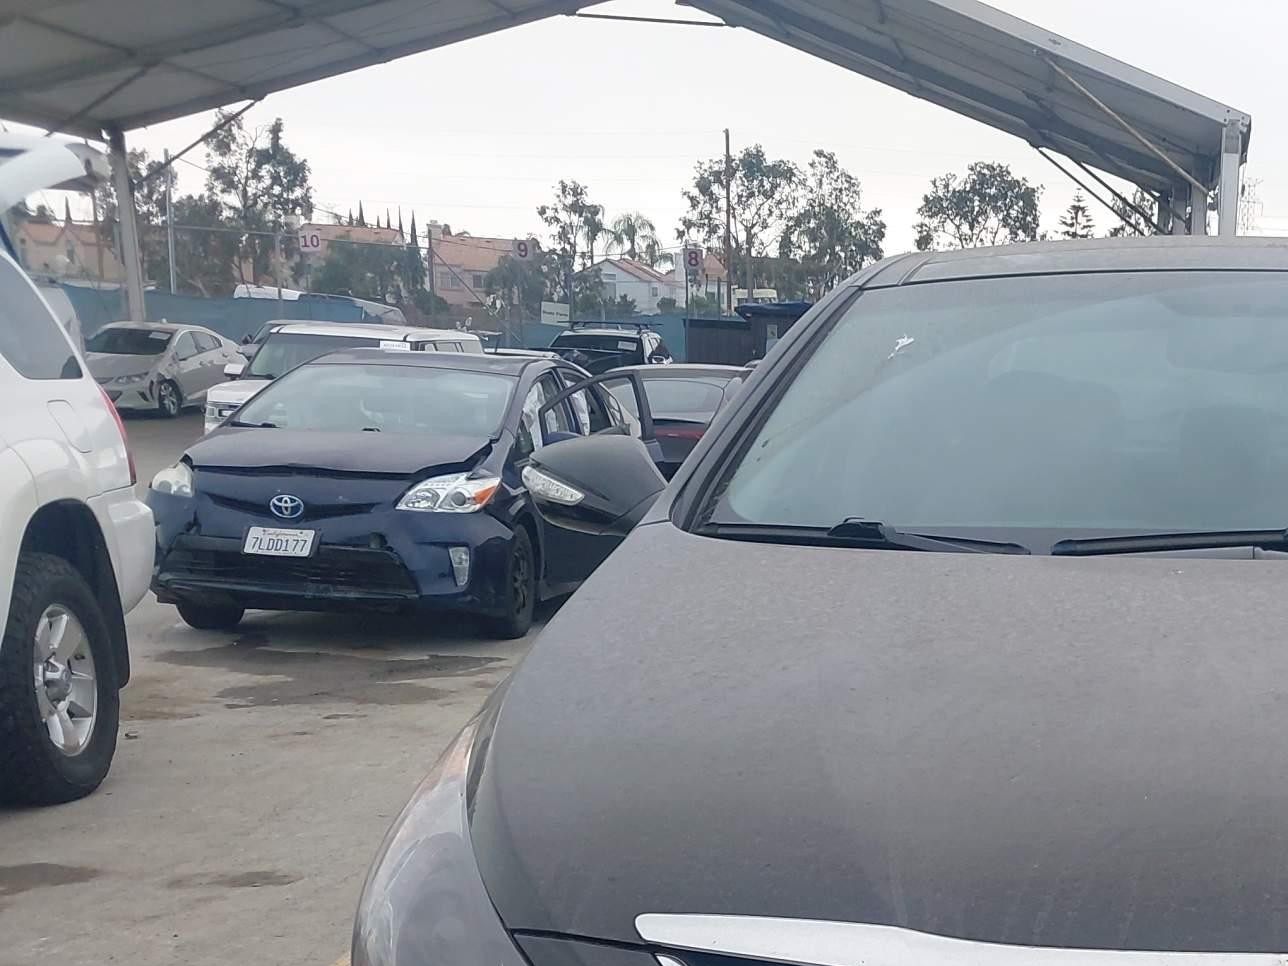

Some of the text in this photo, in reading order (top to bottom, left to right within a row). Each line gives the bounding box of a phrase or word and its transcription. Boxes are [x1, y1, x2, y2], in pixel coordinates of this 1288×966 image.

[301, 234, 320, 248] 10
[517, 242, 529, 258] 9
[687, 250, 700, 267] 8
[251, 536, 309, 553] 7LDD177
